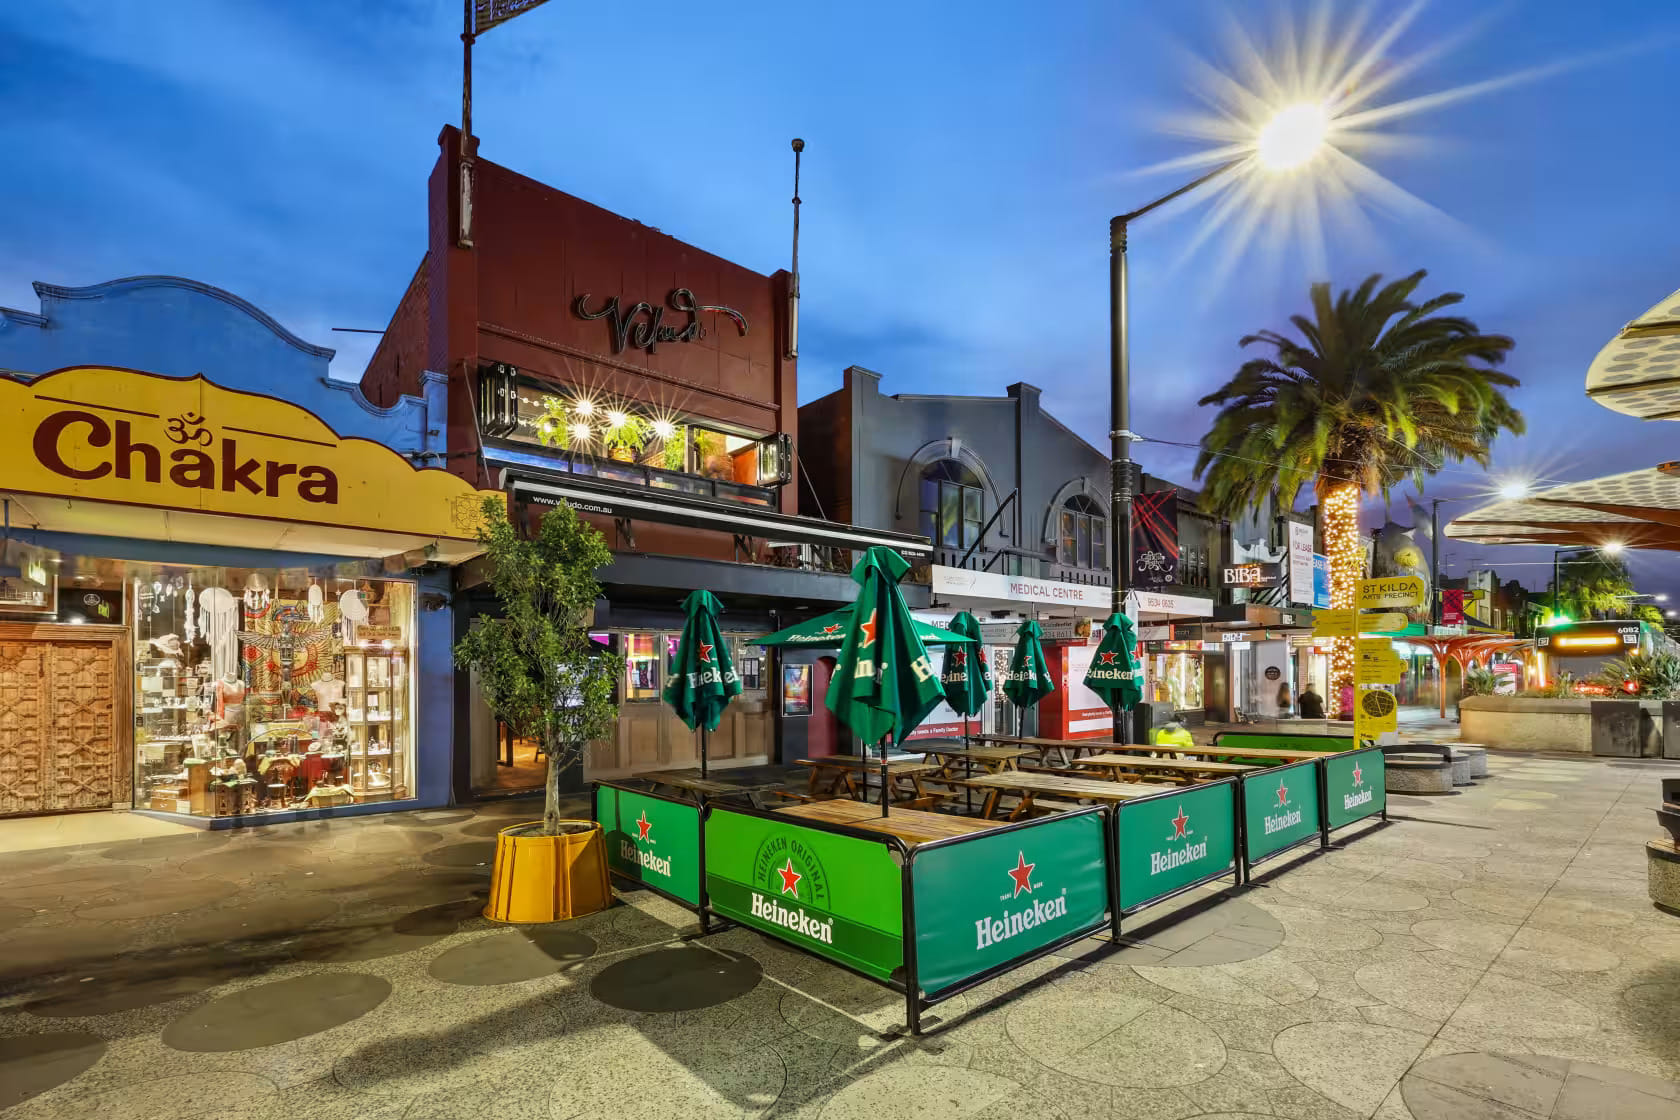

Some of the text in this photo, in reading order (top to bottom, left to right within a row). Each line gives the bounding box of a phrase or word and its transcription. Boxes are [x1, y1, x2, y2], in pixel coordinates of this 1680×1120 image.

[33, 410, 339, 504] Chakra
[1010, 583, 1083, 600] MEDICAL CENTRE
[1224, 567, 1260, 584] BIBA
[1363, 582, 1418, 594] ST KILDA
[1344, 789, 1373, 810] Heineken
[1264, 809, 1302, 835] Heineken
[620, 839, 671, 877] Heineken
[757, 836, 825, 900] HEINEKEN ORIGINAL
[1150, 842, 1207, 876] Heineken
[750, 892, 834, 944] Heineken
[974, 894, 1067, 950] Heineken
